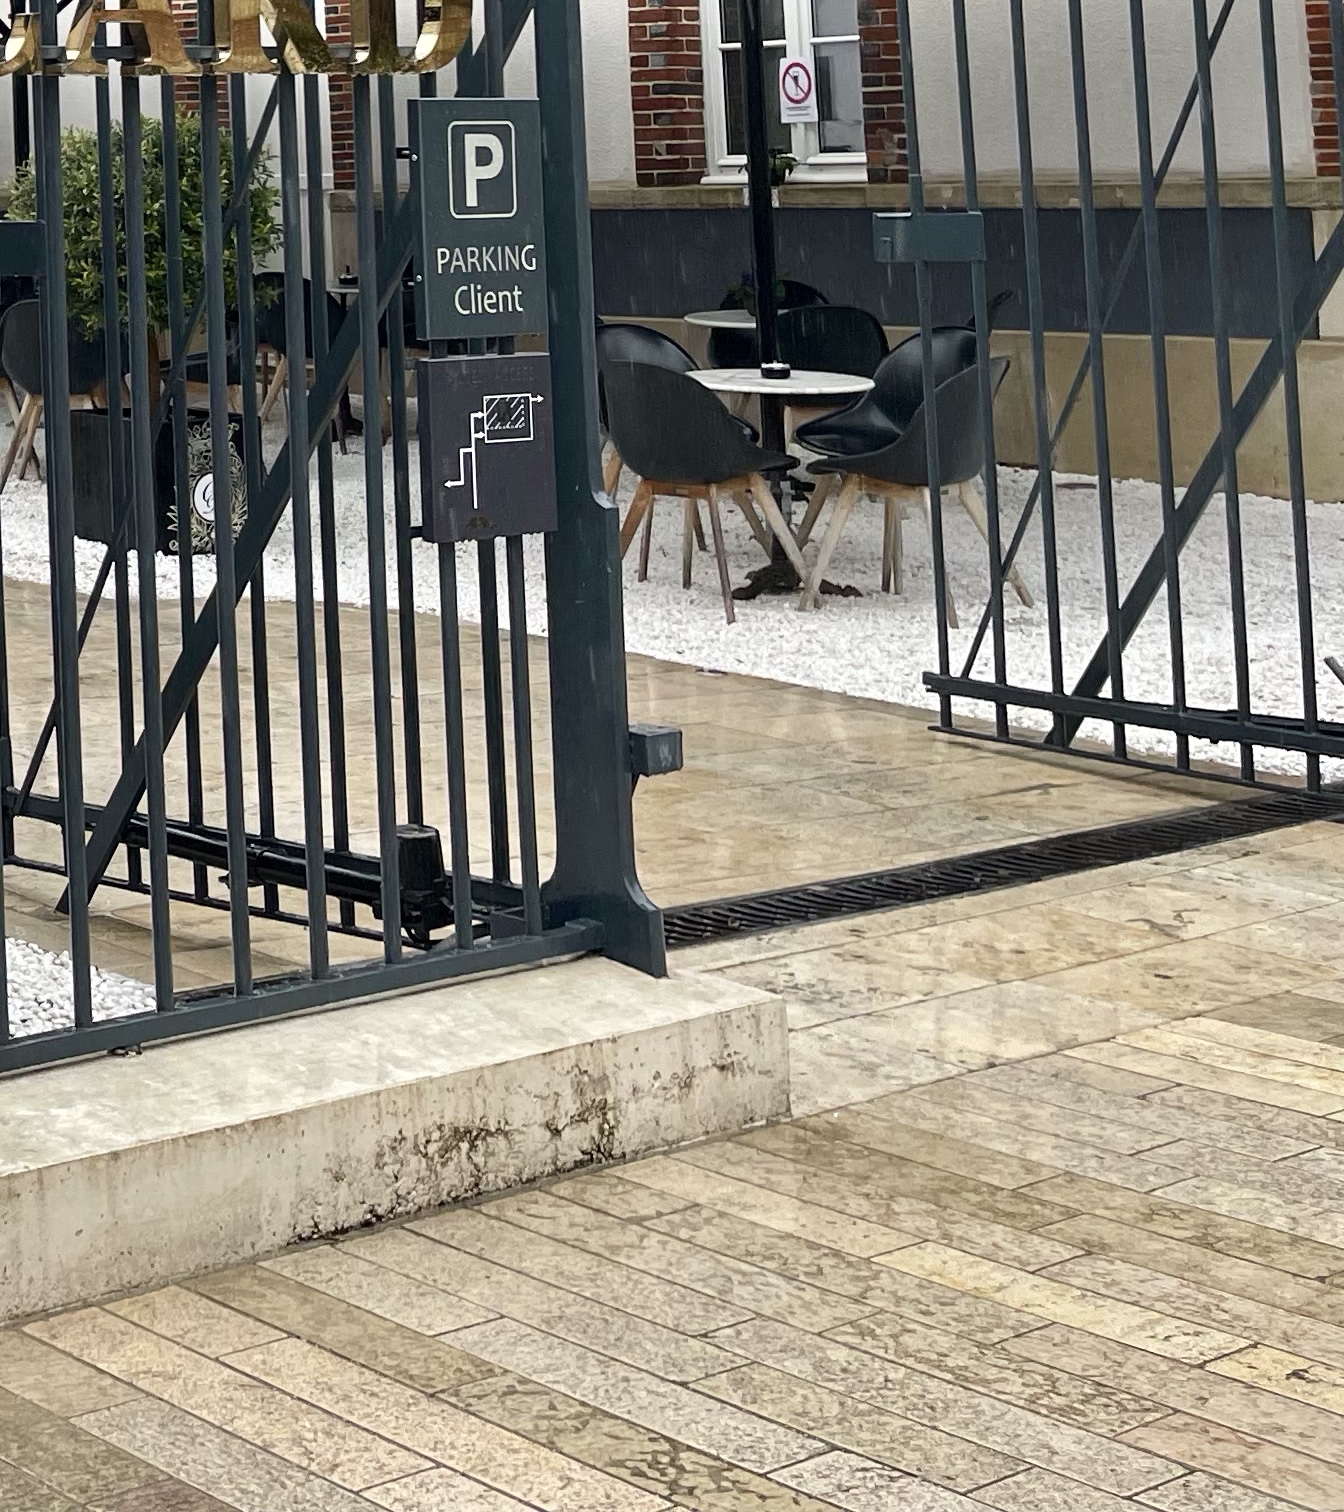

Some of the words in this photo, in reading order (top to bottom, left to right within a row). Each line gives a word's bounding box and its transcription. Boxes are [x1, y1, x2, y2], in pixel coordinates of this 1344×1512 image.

[464, 133, 505, 208] P
[436, 243, 537, 275] PARKING
[454, 284, 524, 315] Client
